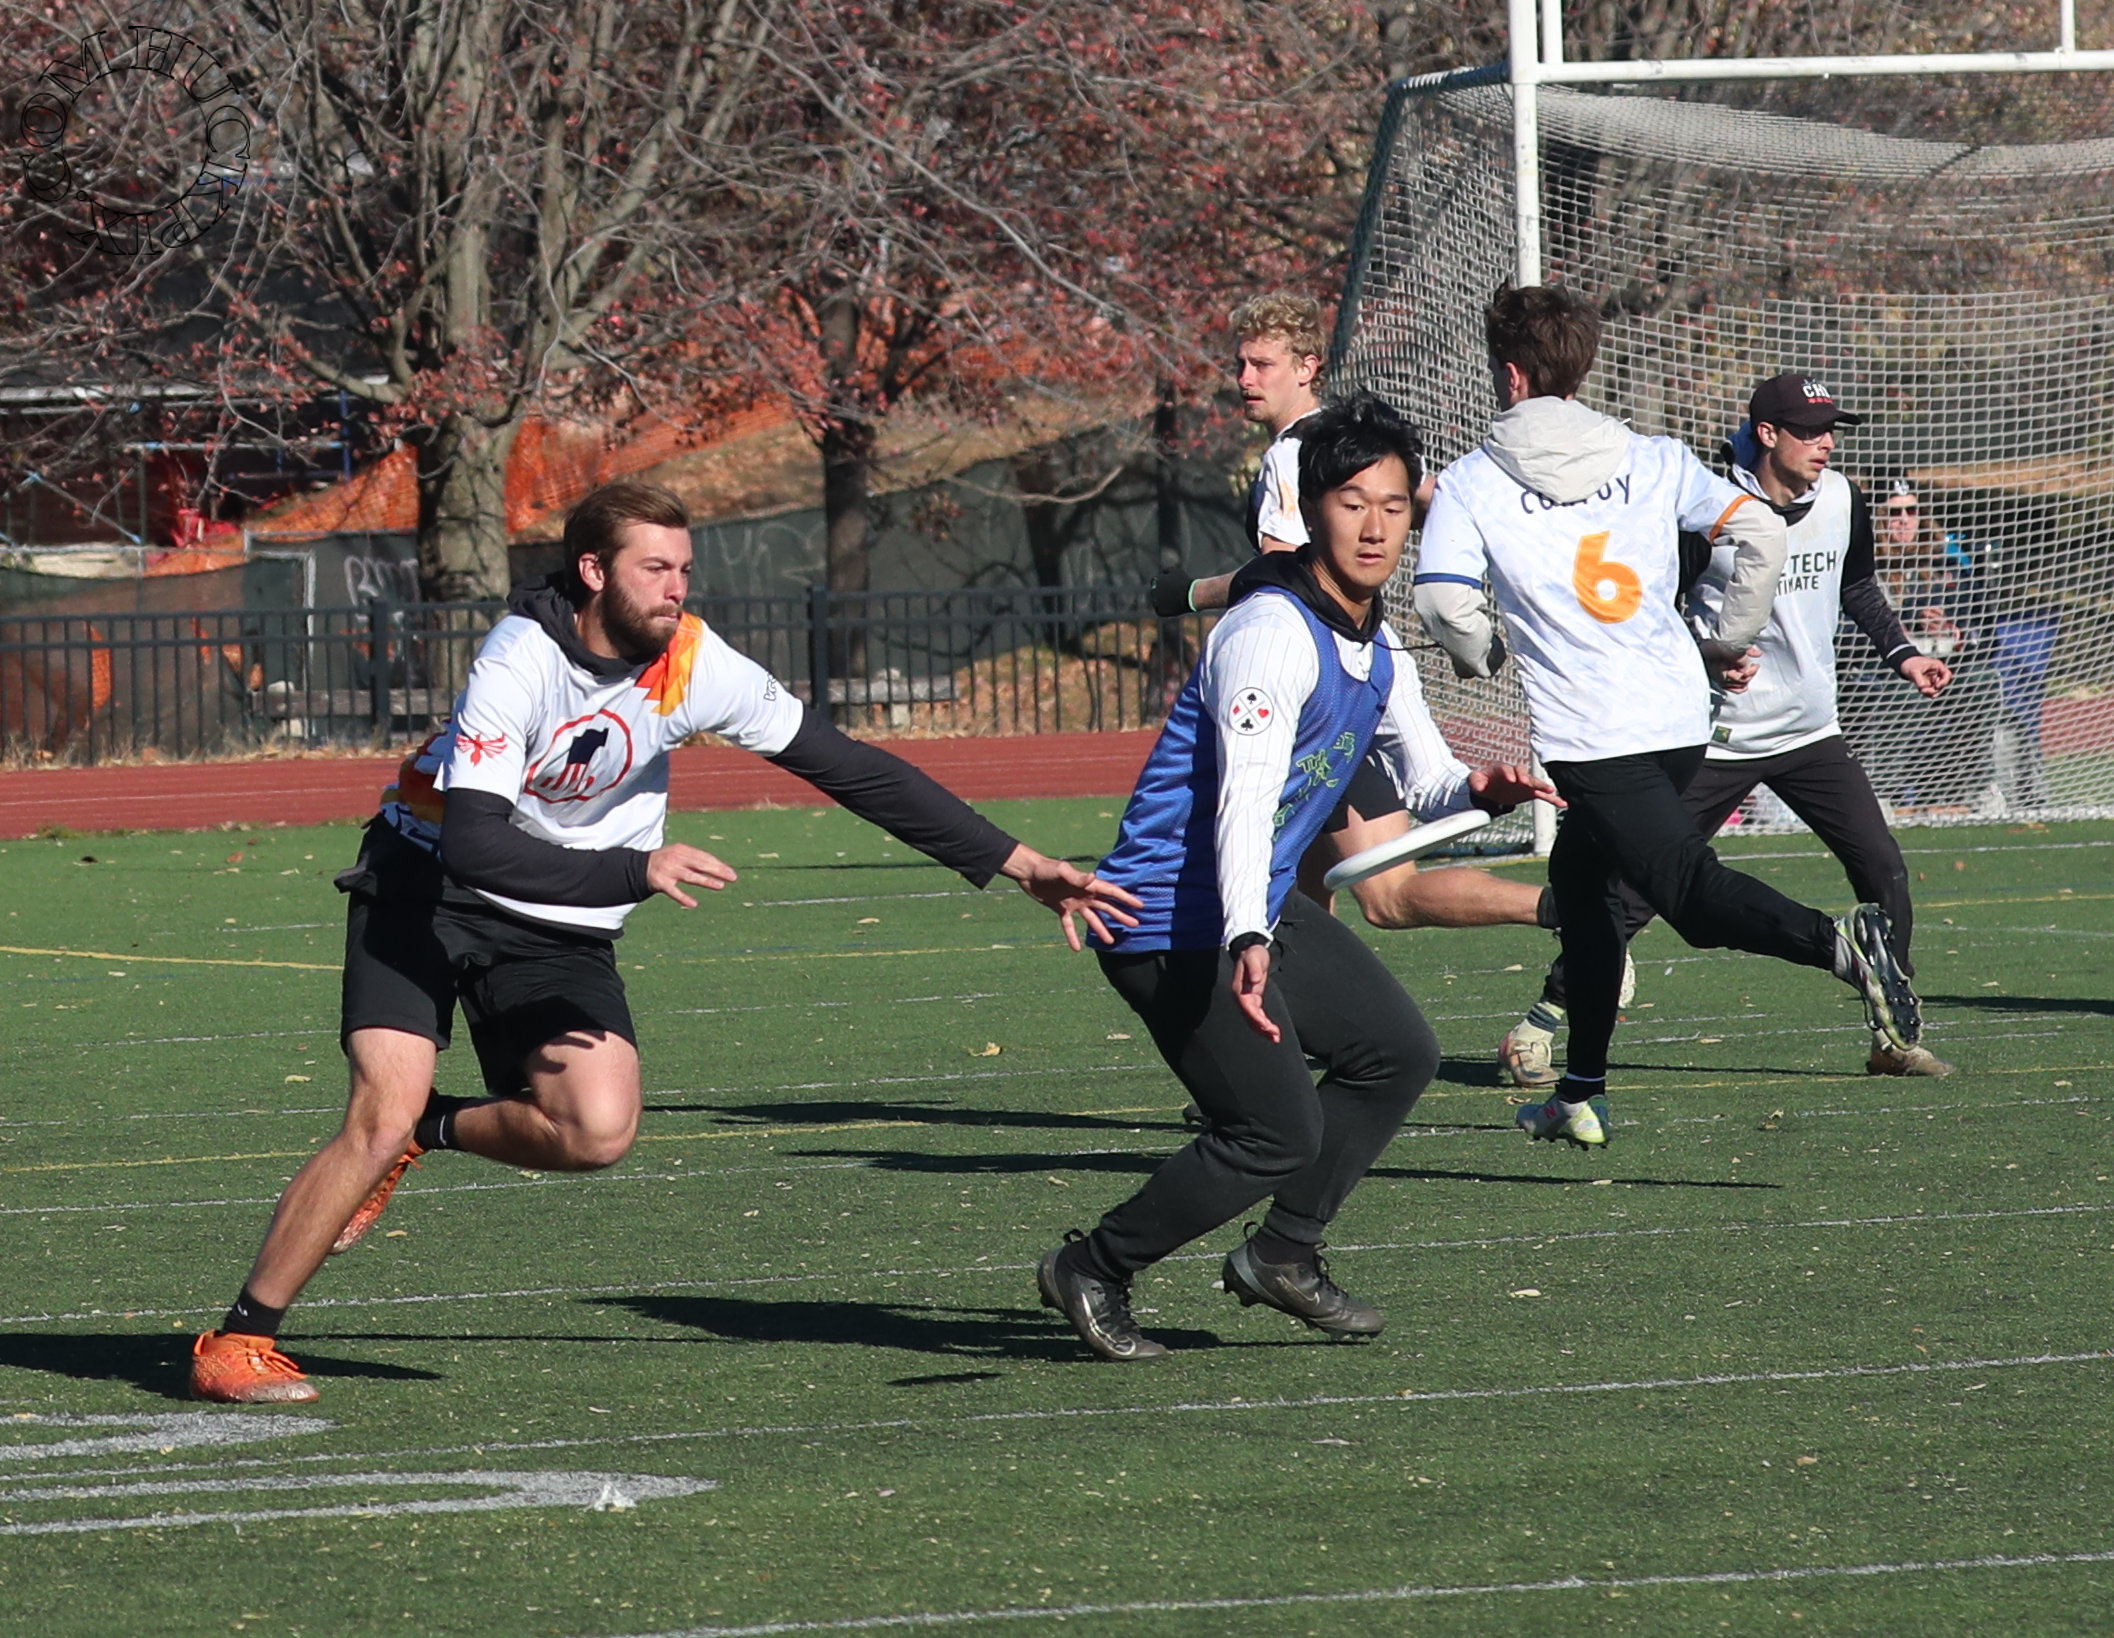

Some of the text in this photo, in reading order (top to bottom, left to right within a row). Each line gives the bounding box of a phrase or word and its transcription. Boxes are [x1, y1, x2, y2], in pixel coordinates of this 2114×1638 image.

[1791, 550, 1837, 574] TECH
[1571, 530, 1643, 624] 6
[1777, 575, 1819, 596] TIMATE
